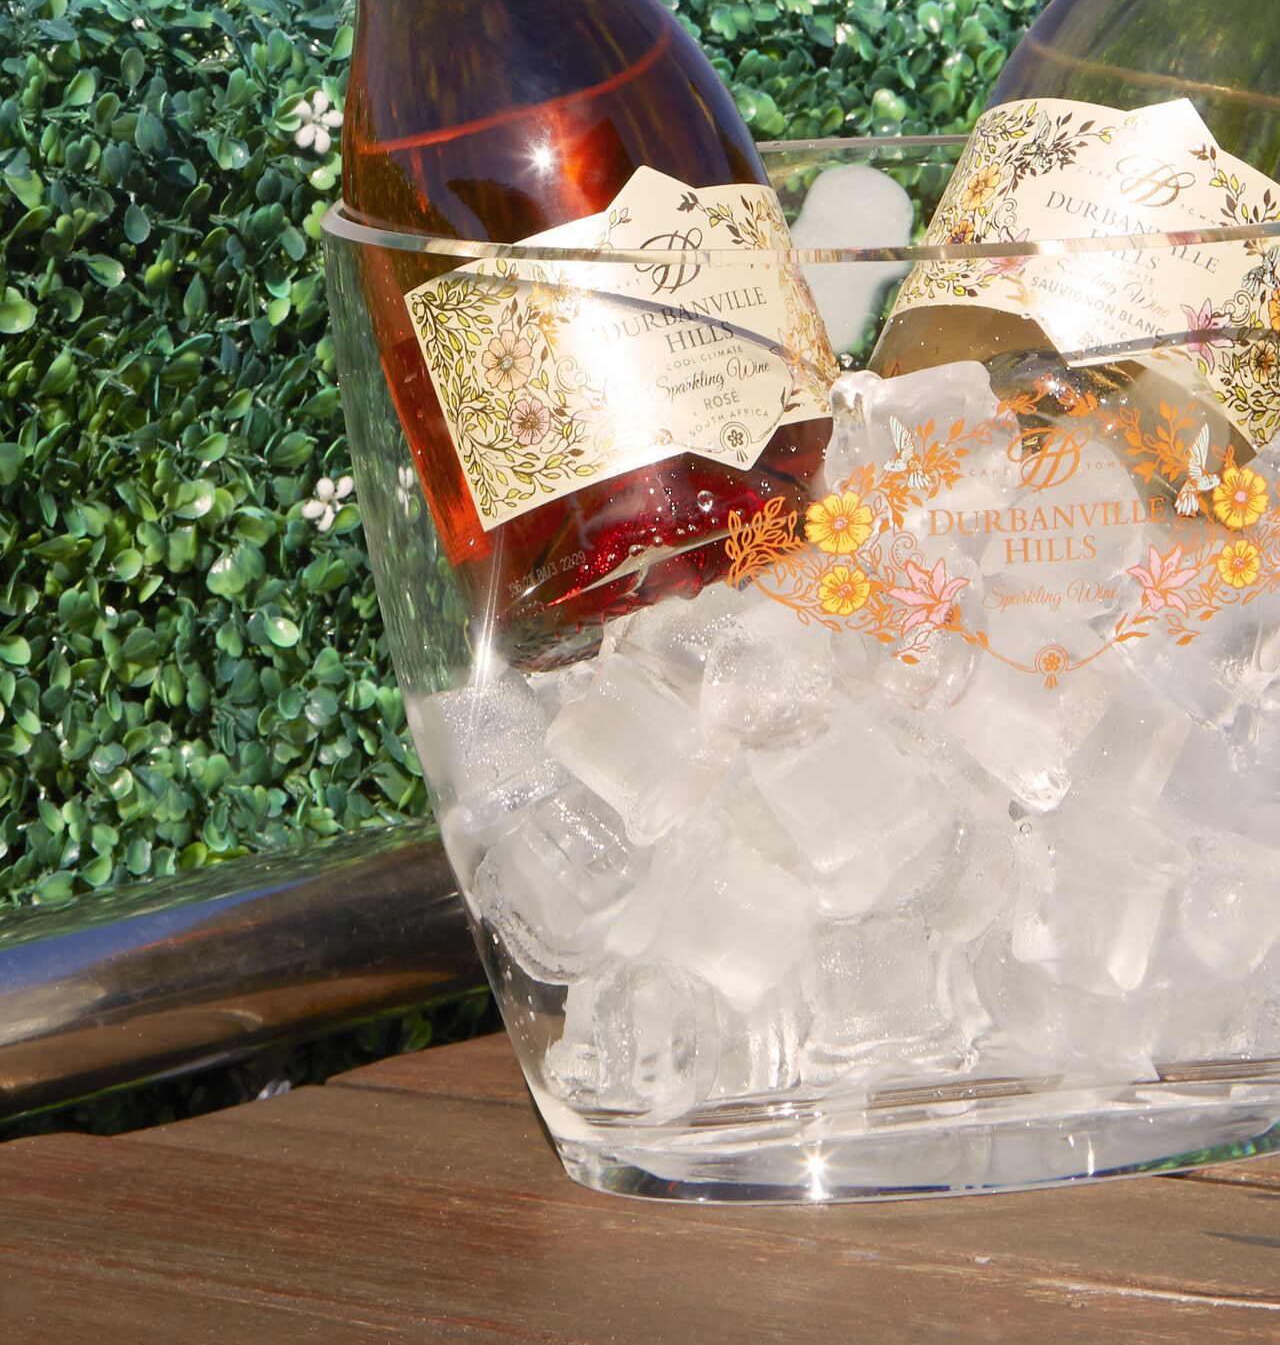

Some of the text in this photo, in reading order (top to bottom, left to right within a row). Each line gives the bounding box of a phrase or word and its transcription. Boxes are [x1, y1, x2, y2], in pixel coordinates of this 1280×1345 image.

[601, 286, 768, 345] DURBANVILLE
[1117, 309, 1166, 340] BLANC
[663, 320, 736, 355] HILLS
[666, 344, 744, 372] COOL CLIMATE
[656, 356, 771, 403] Sparkling Wine
[688, 408, 770, 438] SOUTH AFRICA
[928, 497, 1166, 537] DURBANVILLE
[1004, 534, 1098, 565] HILLS
[982, 577, 1118, 614] Sparkling Wine
